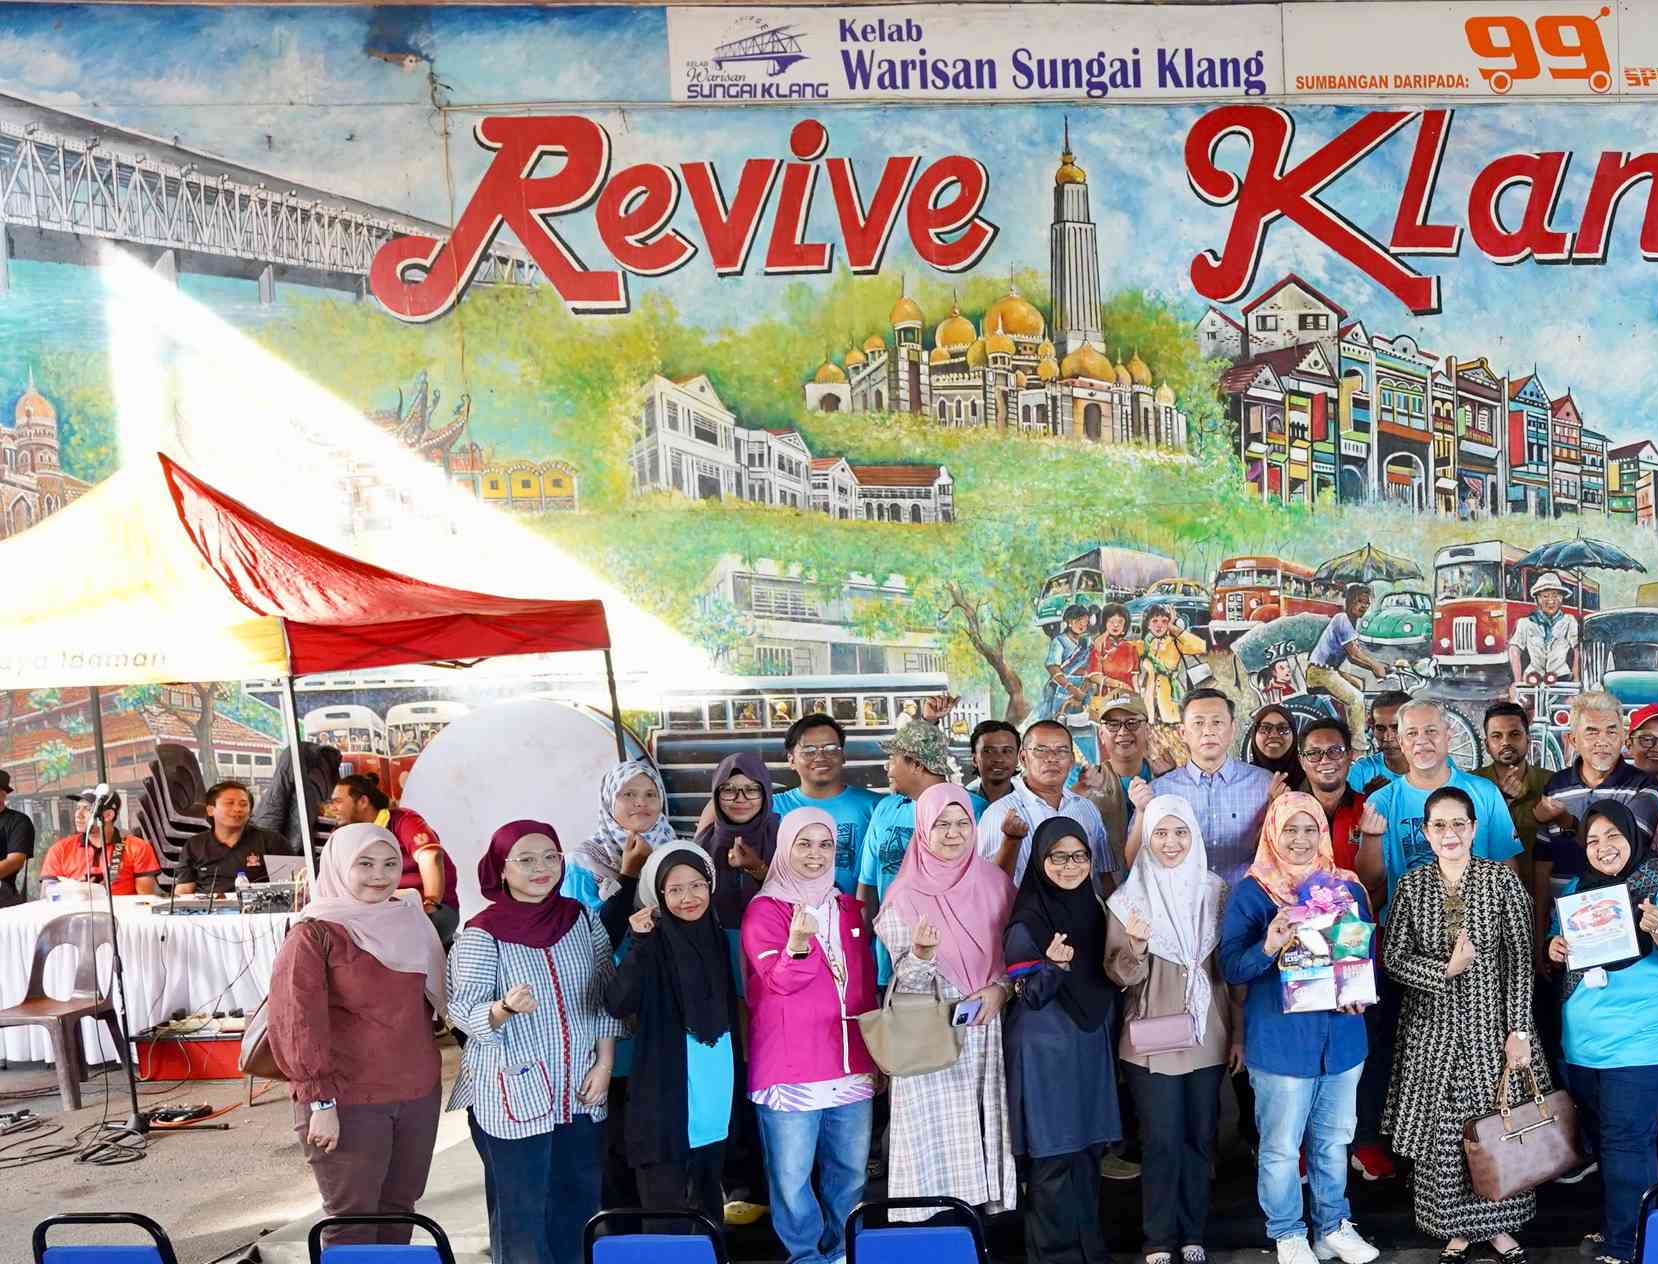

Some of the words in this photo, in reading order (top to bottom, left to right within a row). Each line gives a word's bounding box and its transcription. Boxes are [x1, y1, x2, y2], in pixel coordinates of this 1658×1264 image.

[839, 18, 923, 42] Kelab
[1296, 74, 1389, 90] SUMBANGAN
[1393, 73, 1469, 89] DARIPADA:
[1464, 15, 1612, 93] 99
[687, 83, 757, 98] SUNGAI
[761, 83, 829, 98] KLANG
[841, 48, 997, 90] Warisan
[1012, 48, 1142, 98] Sungai
[1157, 48, 1267, 96] Klang
[371, 115, 1000, 324] Revive
